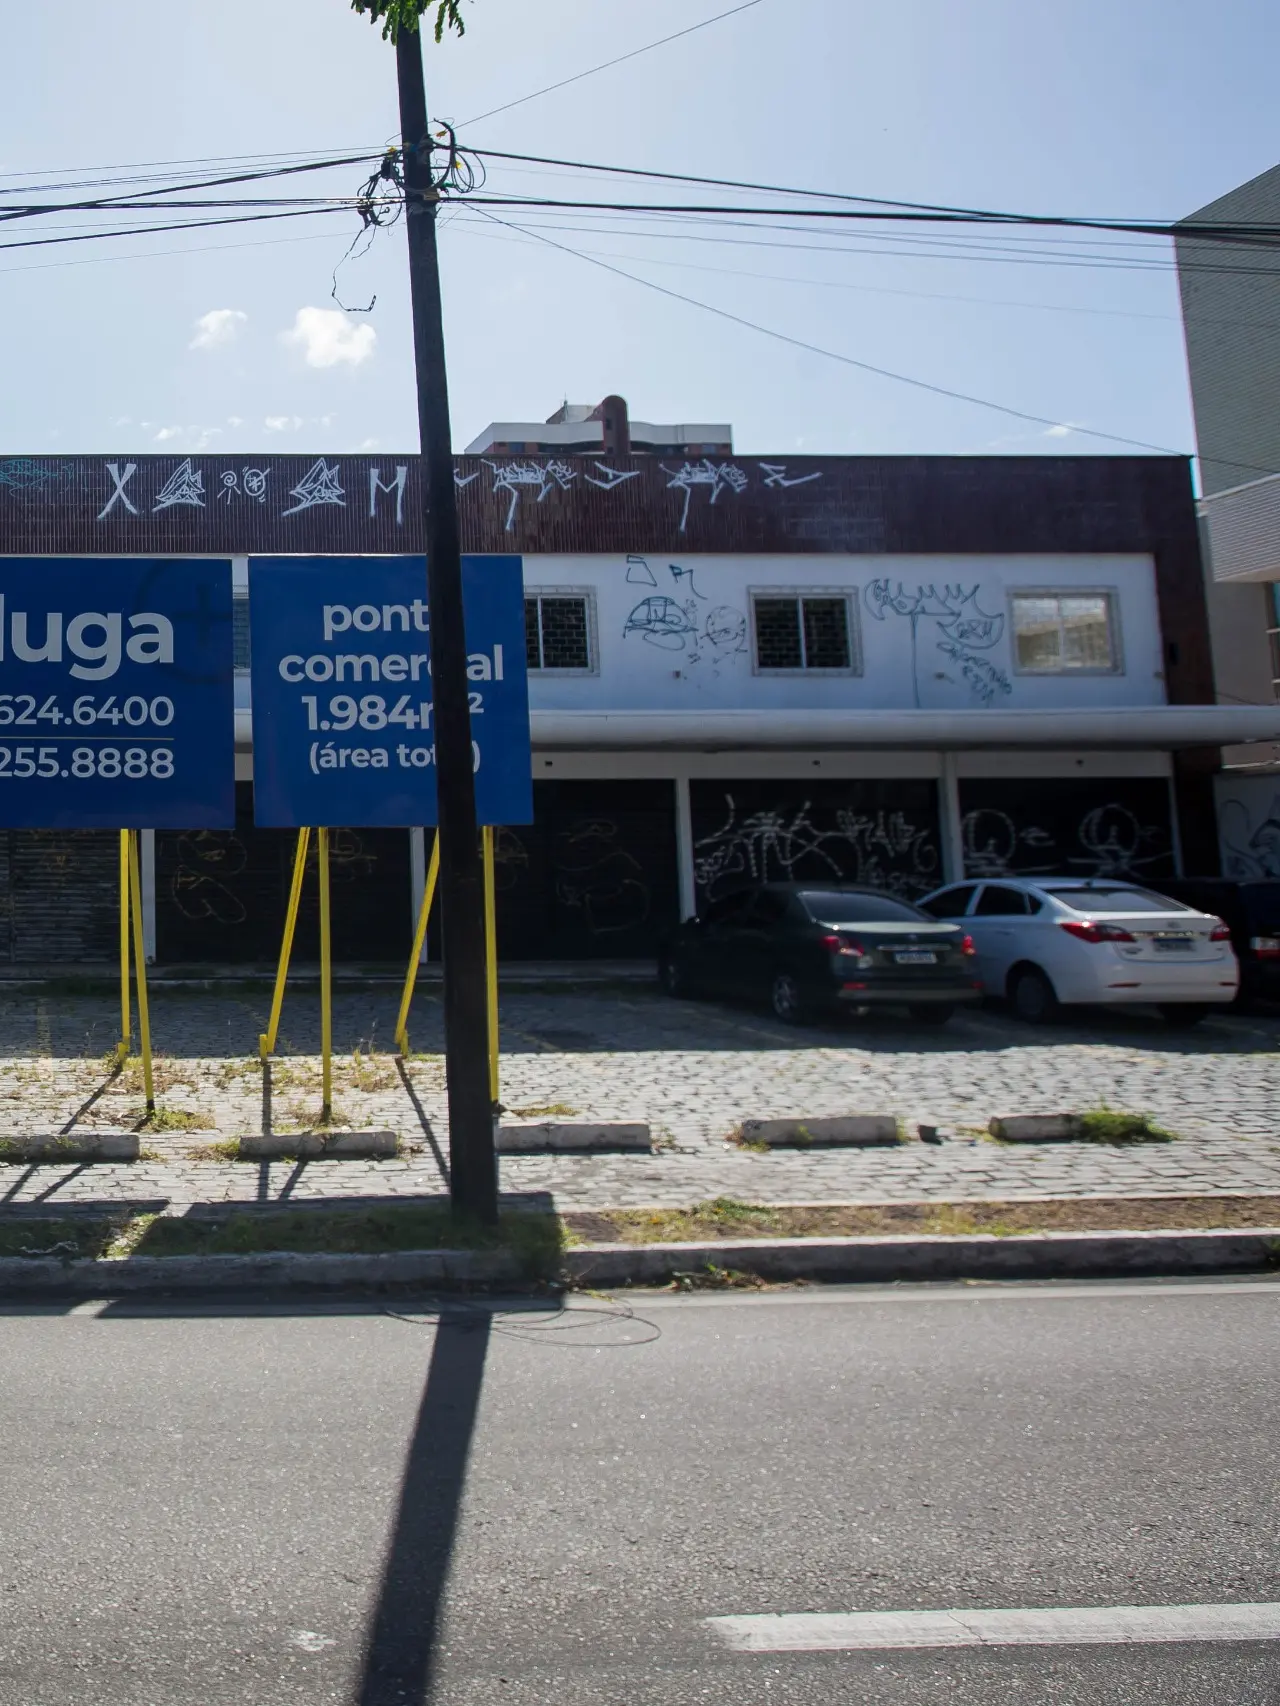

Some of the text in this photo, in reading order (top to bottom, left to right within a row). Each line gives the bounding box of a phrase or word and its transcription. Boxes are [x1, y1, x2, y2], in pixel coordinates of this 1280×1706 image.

[322, 599, 431, 641] pont
[278, 644, 504, 682] comeral
[309, 741, 389, 775] (área
